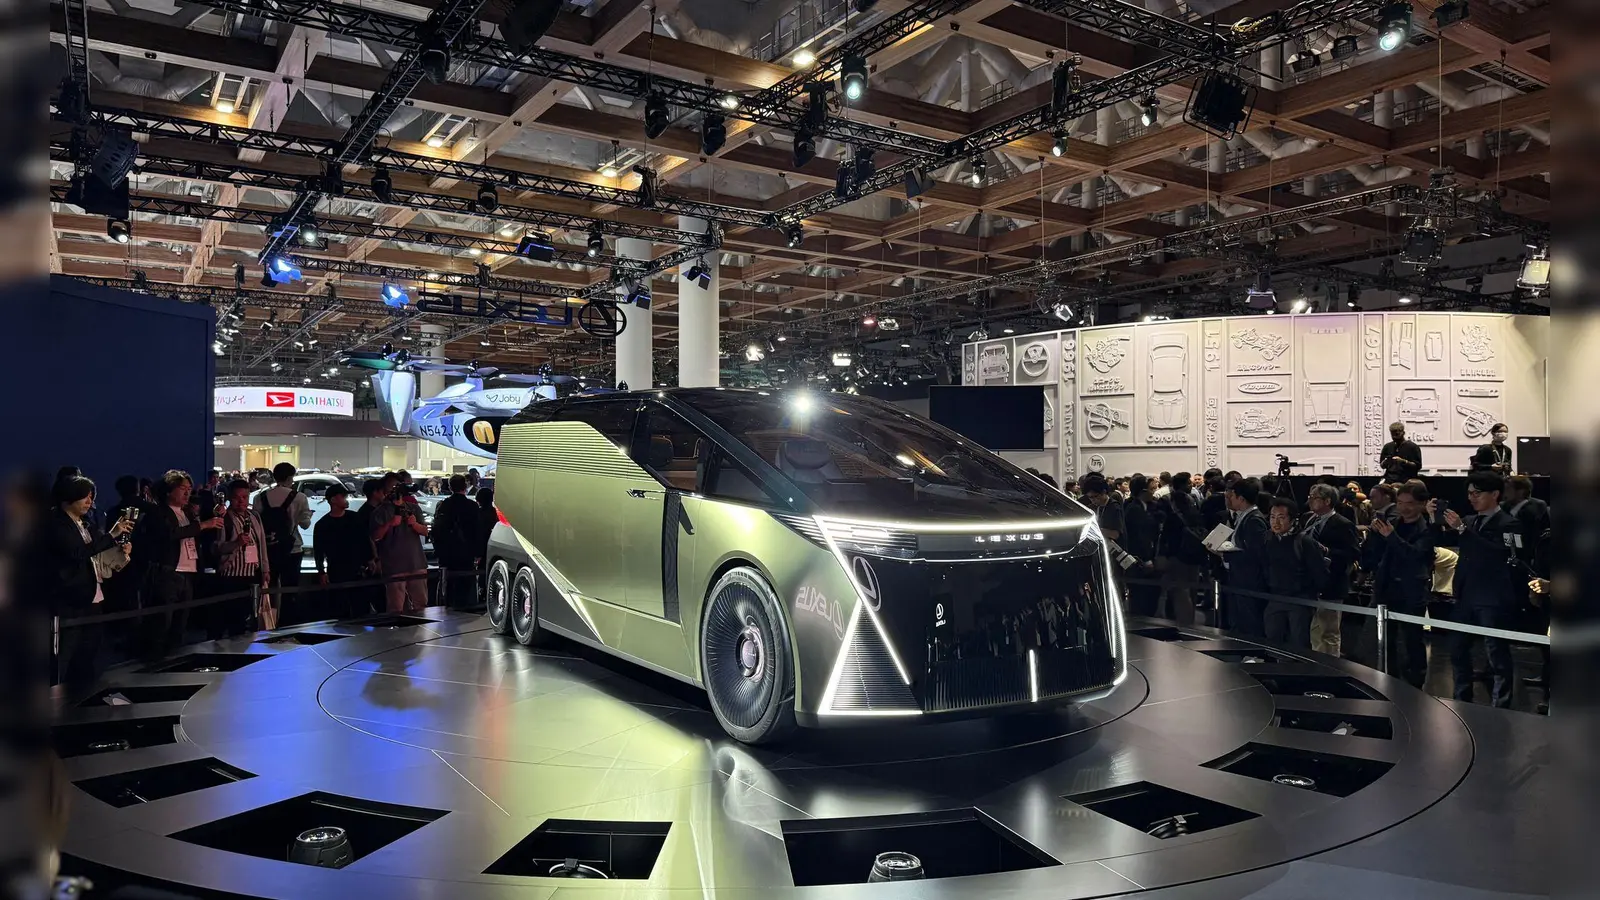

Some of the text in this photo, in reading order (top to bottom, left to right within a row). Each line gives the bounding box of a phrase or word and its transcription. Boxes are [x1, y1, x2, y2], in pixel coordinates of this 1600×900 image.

[1204, 329, 1220, 371] 1951
[1365, 325, 1381, 370] 1967
[1062, 339, 1076, 383] 1966
[966, 353, 975, 385] 954
[299, 395, 345, 407] DAIHATSU
[499, 394, 520, 404] Joby
[419, 424, 461, 437] N542JX
[1146, 431, 1188, 443] Corolla
[974, 533, 1044, 543] LEXUS
